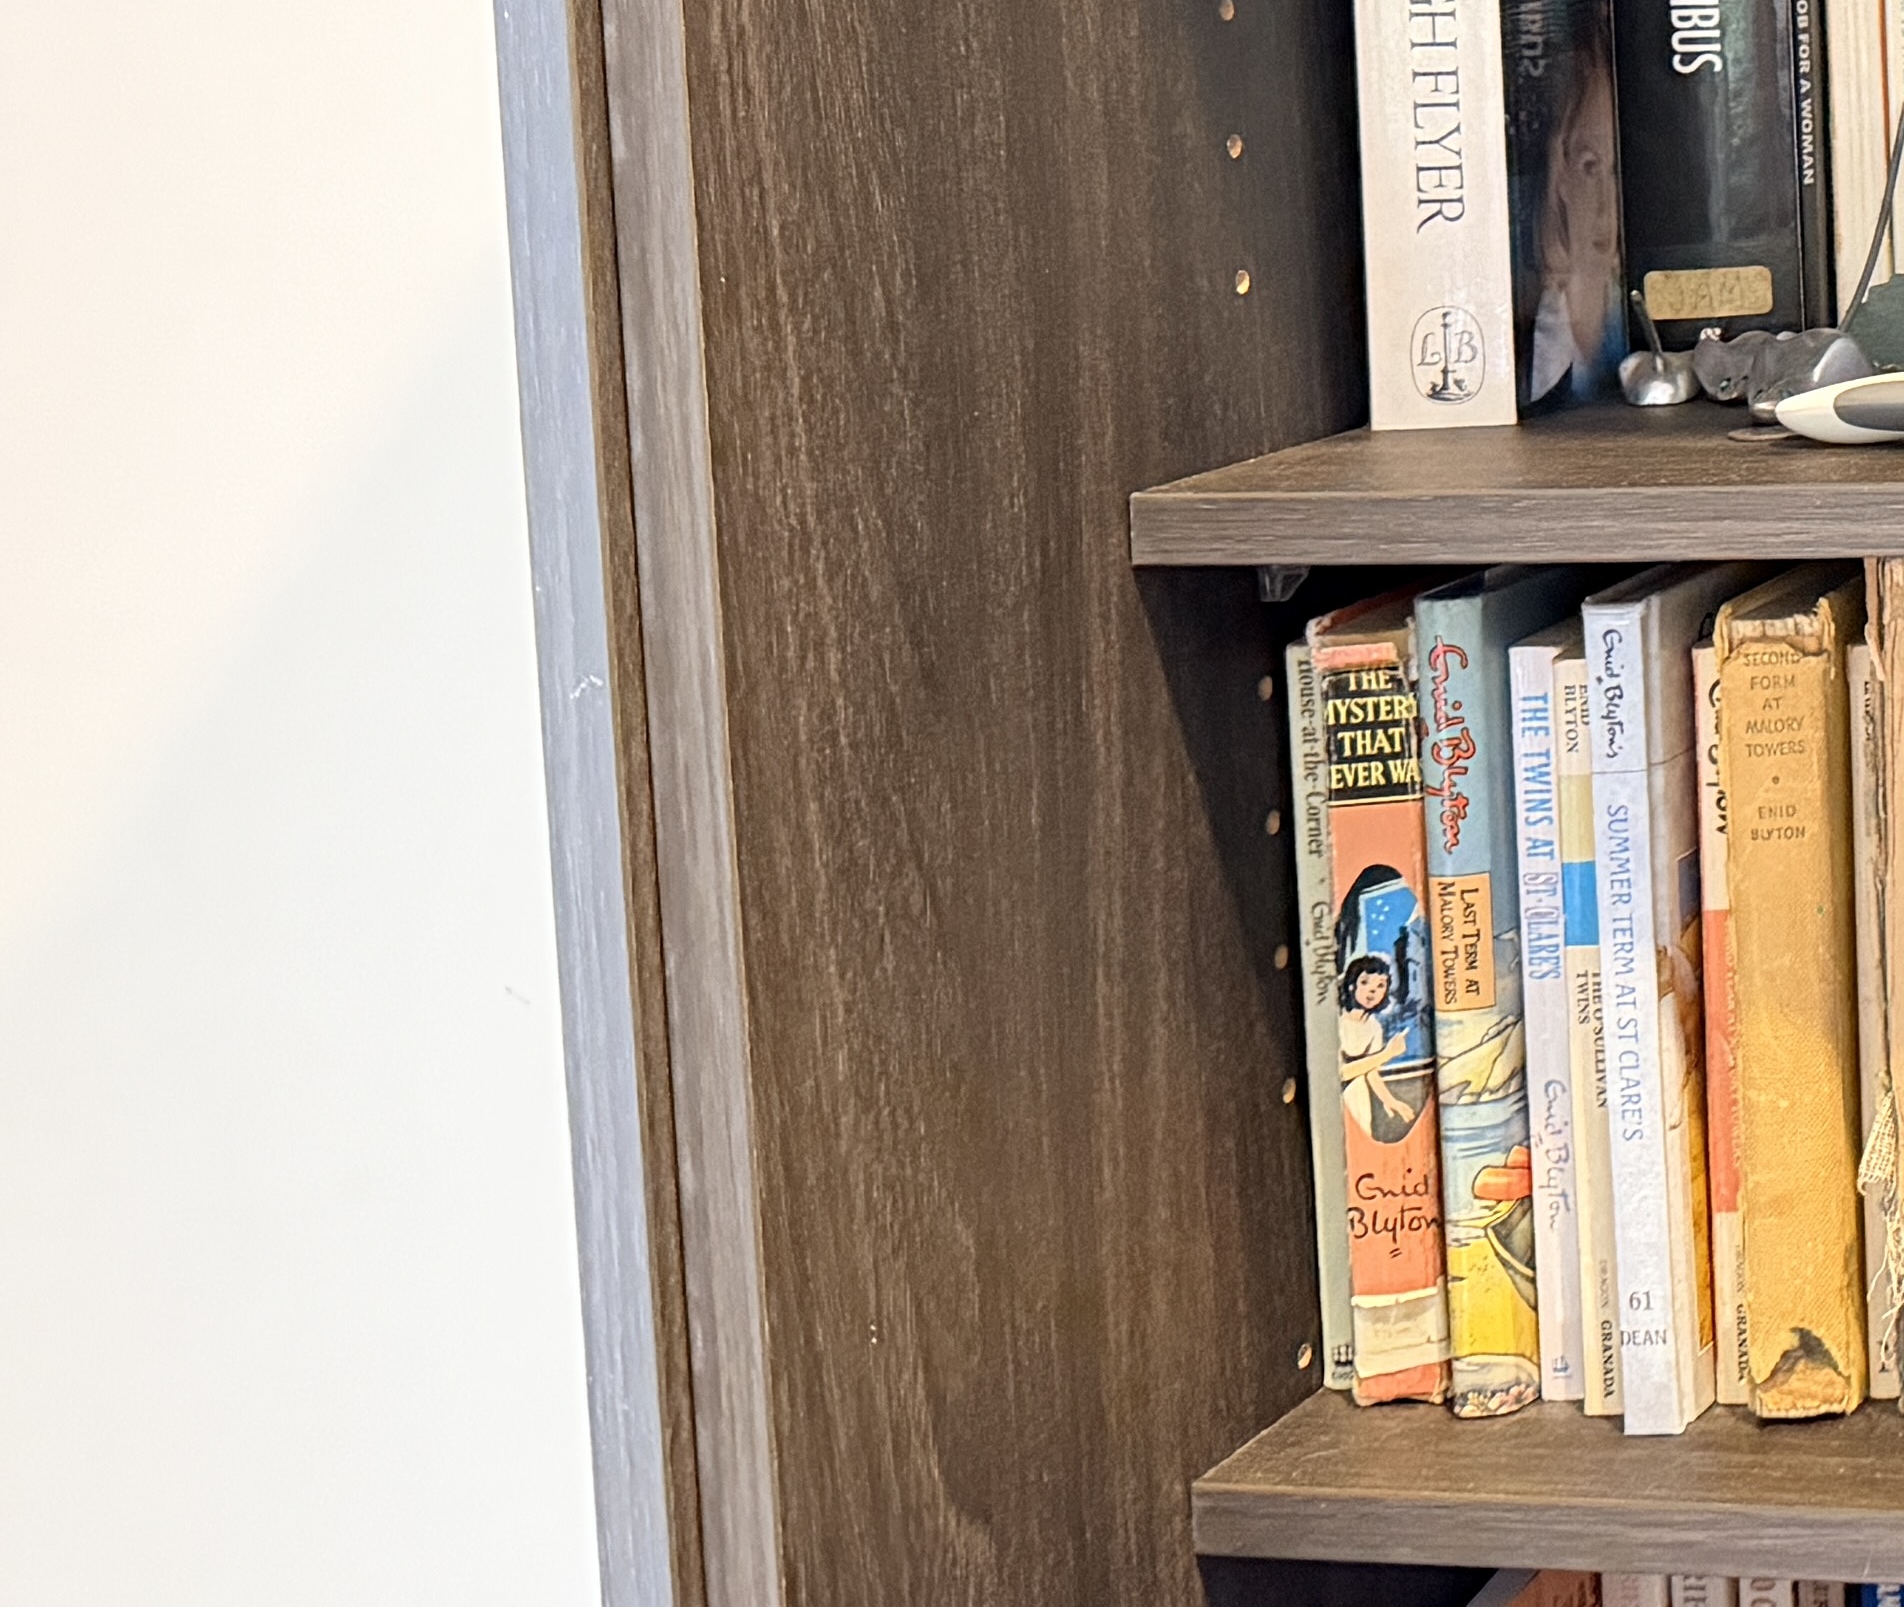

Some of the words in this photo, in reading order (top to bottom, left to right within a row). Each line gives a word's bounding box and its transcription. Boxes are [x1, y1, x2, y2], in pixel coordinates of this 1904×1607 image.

[1412, 68, 1467, 234] FLYER
[1354, 1170, 1430, 1199] Enid
[1348, 1206, 1440, 1239] Blyton
[1629, 1291, 1653, 1311] 61
[1621, 1328, 1667, 1346] DEAN
